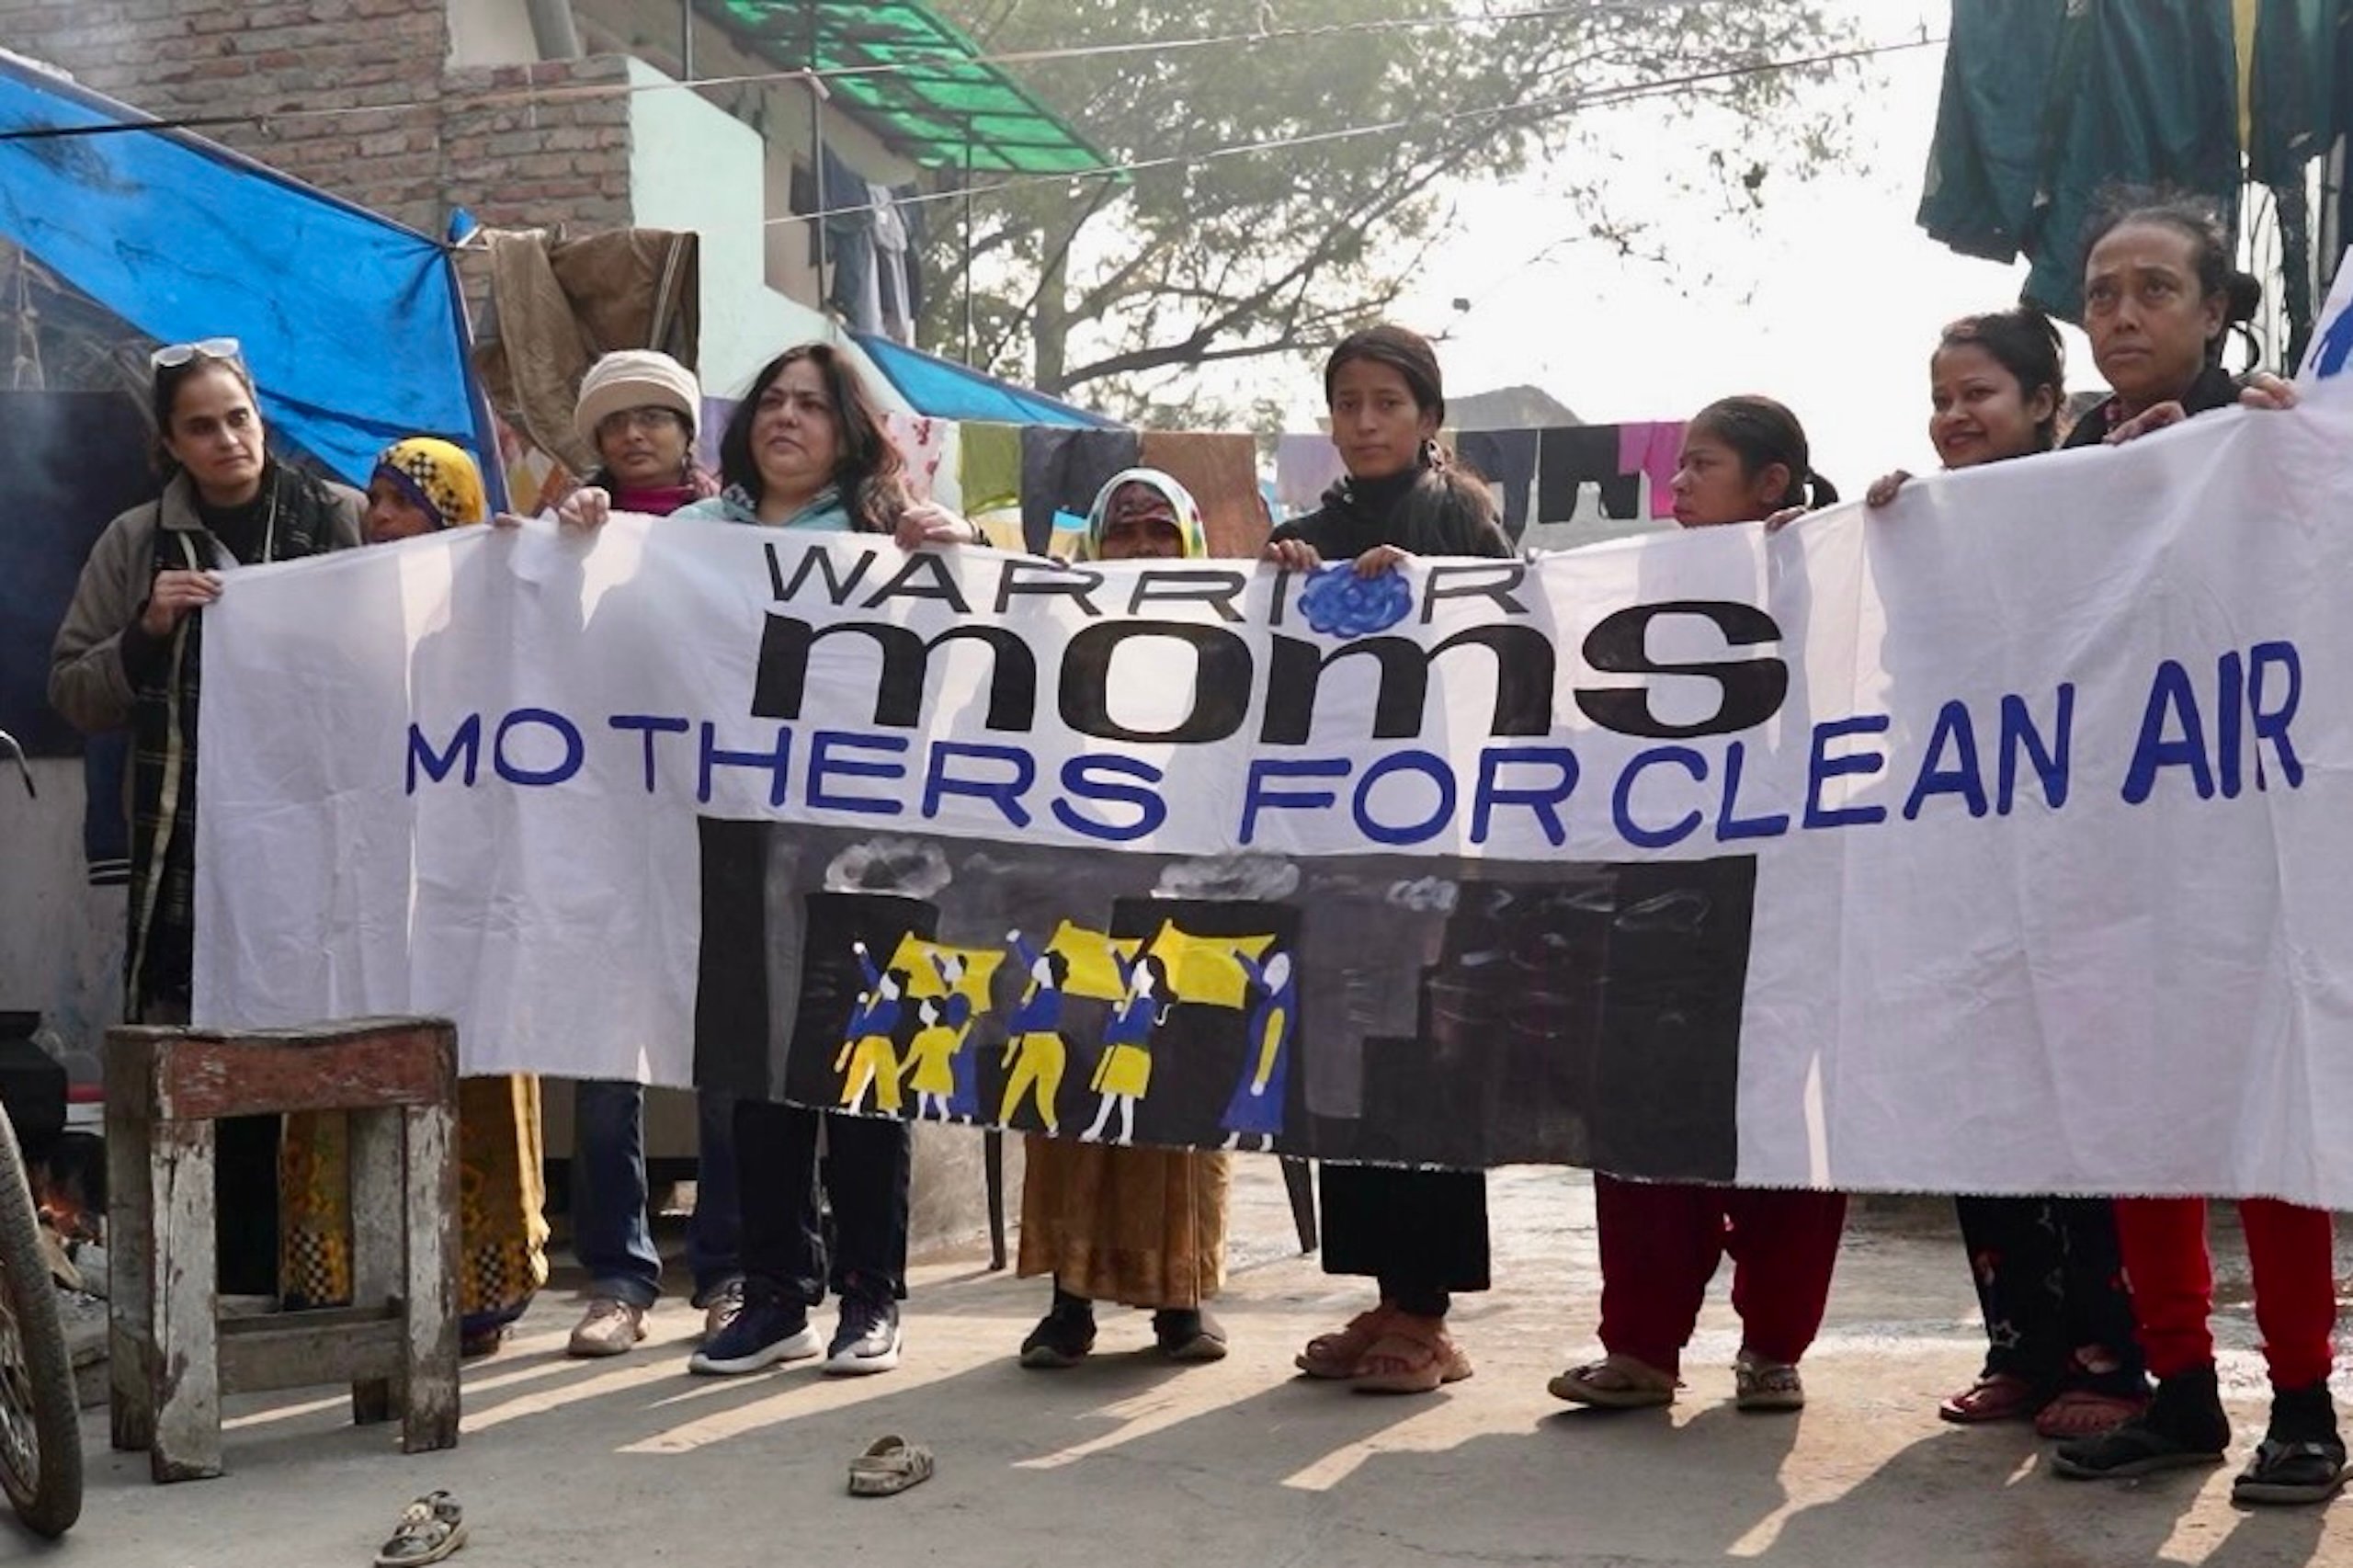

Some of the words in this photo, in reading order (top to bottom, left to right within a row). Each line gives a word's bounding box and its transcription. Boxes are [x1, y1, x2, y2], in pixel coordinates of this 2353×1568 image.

[750, 600, 1790, 745] moms
[1238, 745, 1579, 846] FOR
[1610, 683, 2074, 846] CLEAN
[2121, 641, 2303, 804] AIR
